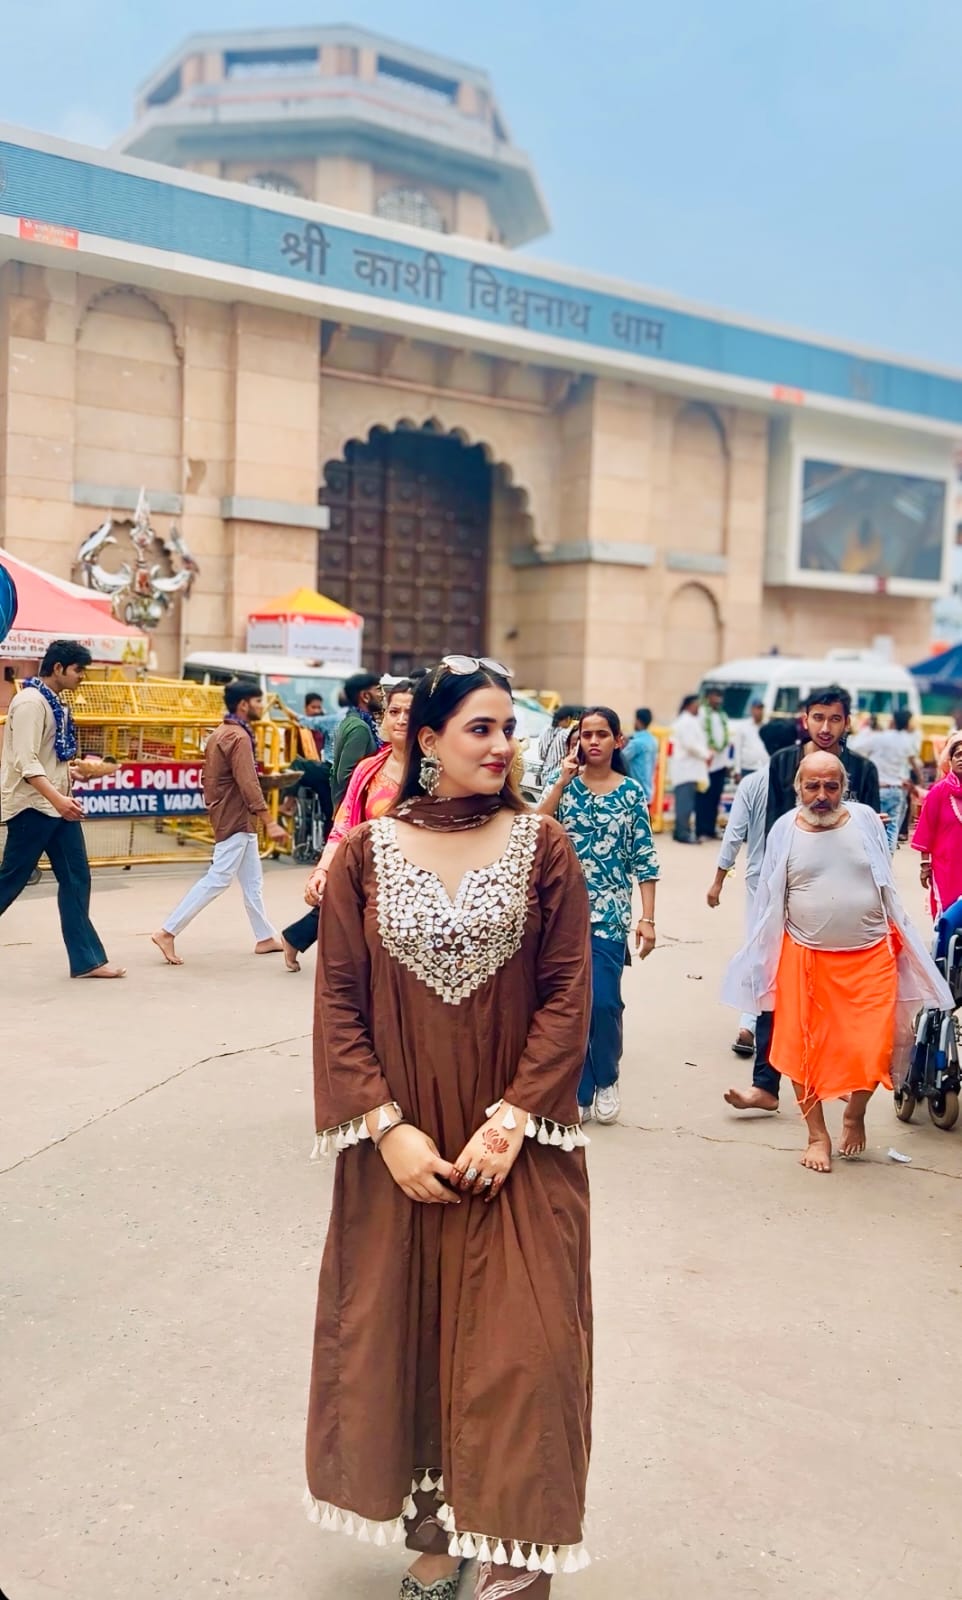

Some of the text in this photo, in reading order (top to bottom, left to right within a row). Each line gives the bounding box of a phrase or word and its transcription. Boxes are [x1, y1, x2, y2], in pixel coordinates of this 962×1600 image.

[281, 222, 665, 350] श्री काशी विश्वनाथ धाम
[163, 793, 206, 810] VARA
